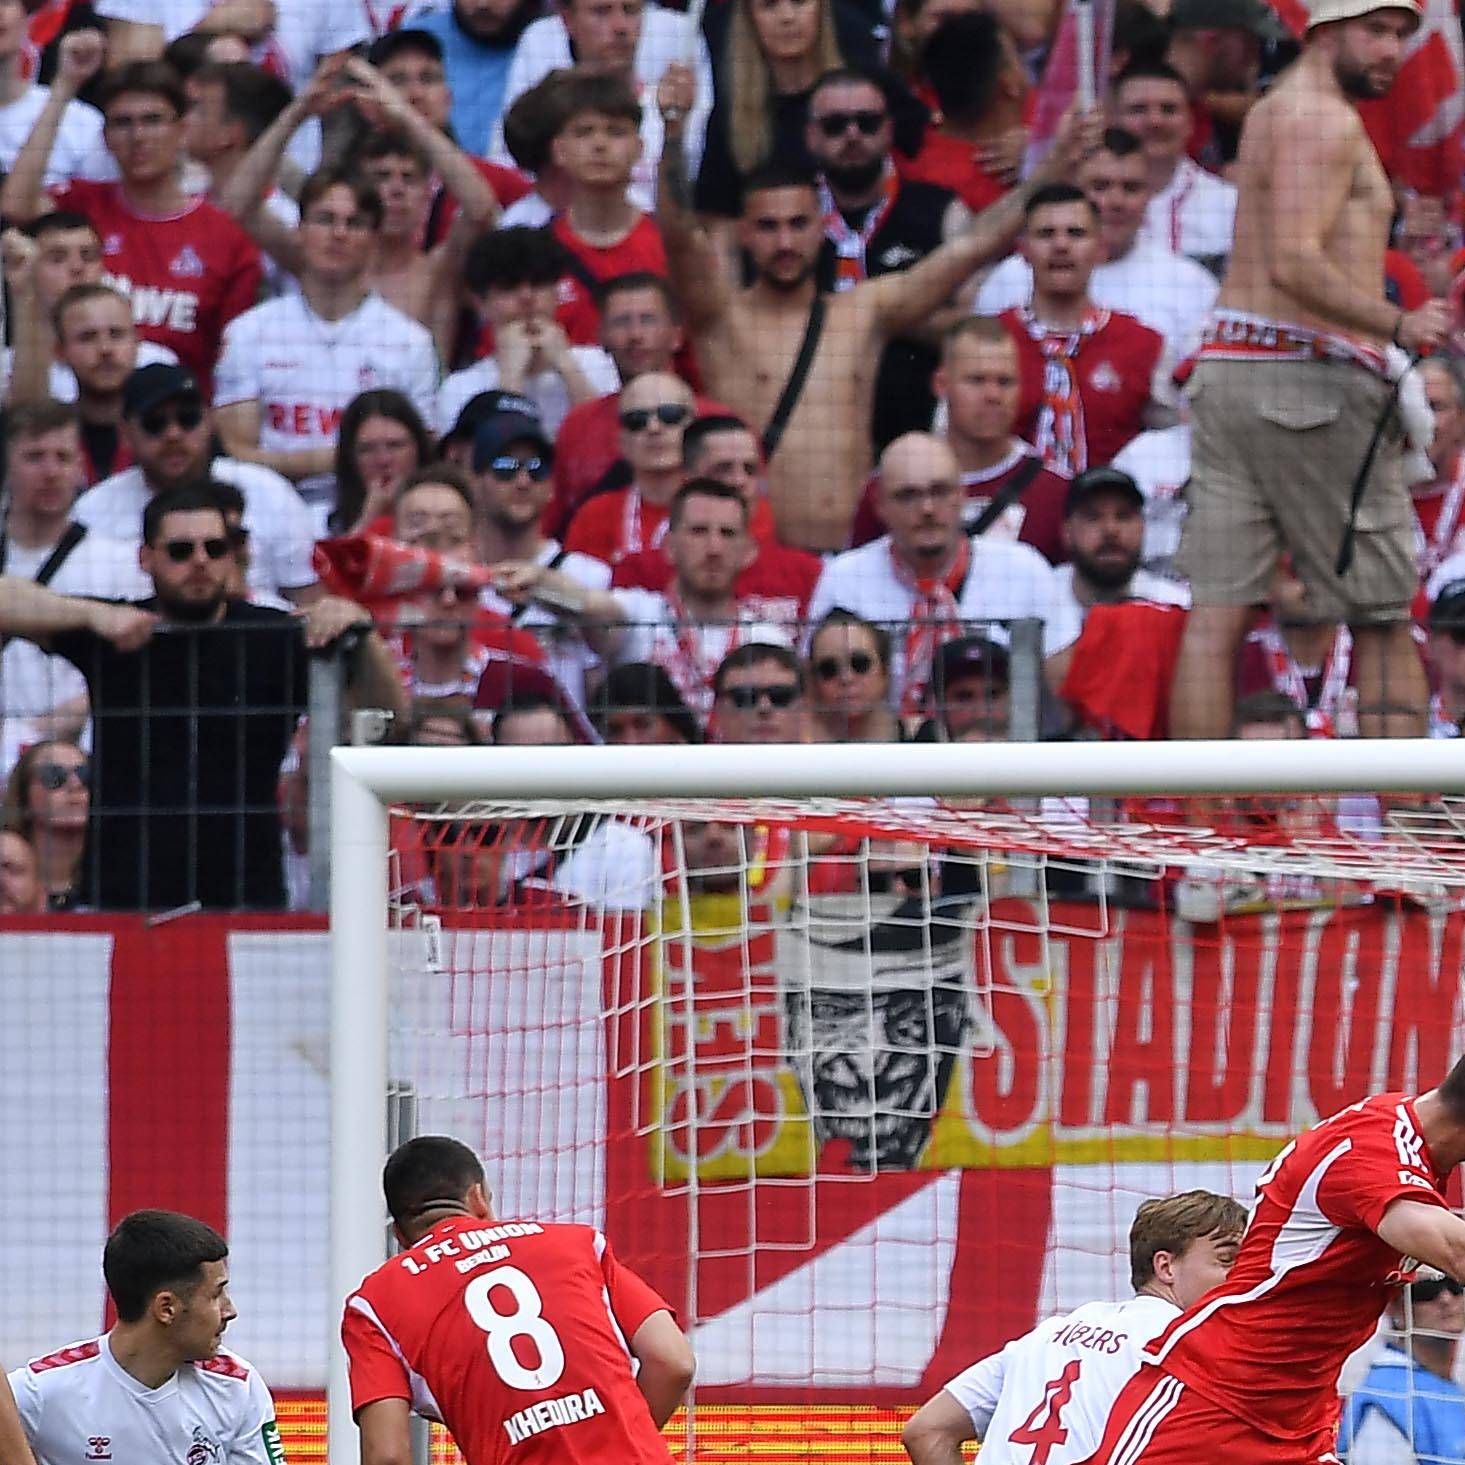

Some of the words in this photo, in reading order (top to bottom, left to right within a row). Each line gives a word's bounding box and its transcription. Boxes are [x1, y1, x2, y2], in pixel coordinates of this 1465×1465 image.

[269, 404, 342, 435] REW
[401, 1255, 427, 1275] 1.
[424, 1237, 460, 1263] FC
[459, 1222, 545, 1250] UNION
[454, 1243, 511, 1274] BERLIN
[464, 1265, 565, 1391] 8
[502, 1388, 606, 1447] KHEDIRA
